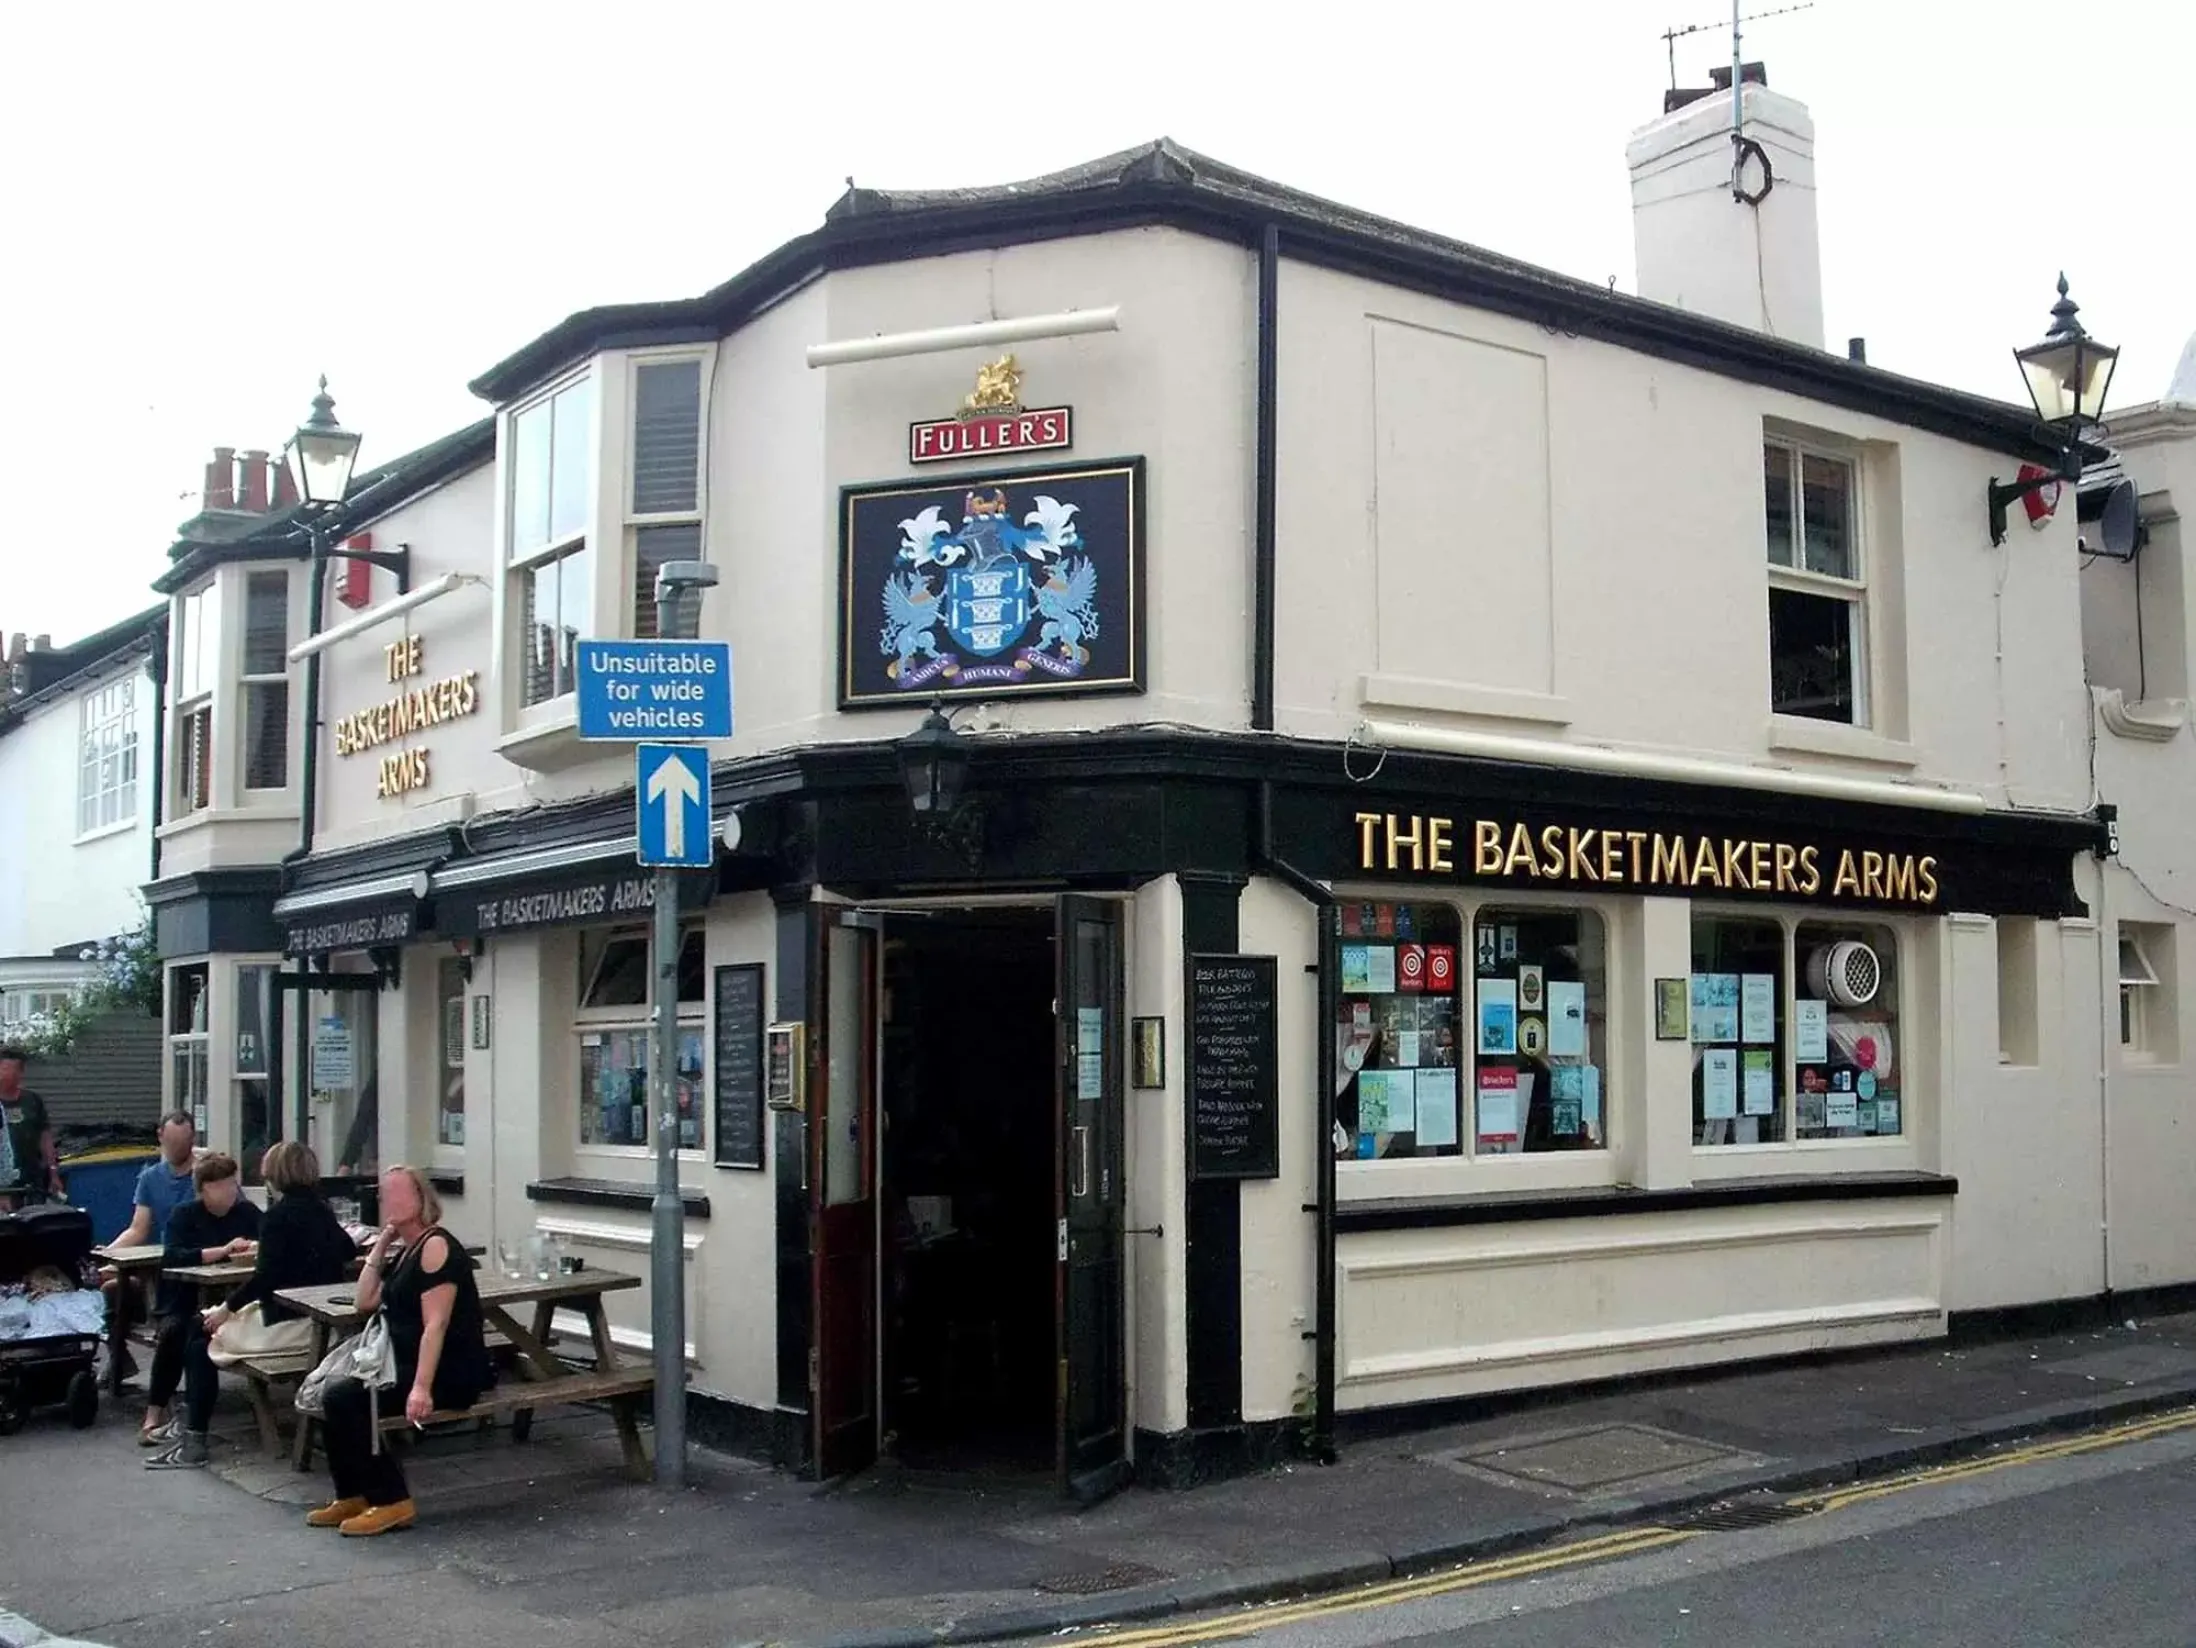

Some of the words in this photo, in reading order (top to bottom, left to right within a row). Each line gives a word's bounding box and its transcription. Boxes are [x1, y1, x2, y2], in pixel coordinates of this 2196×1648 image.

[919, 416, 1058, 454] FULLER'S
[384, 633, 423, 684] THE
[591, 652, 716, 674] Unsuitable
[963, 668, 1012, 681] HUMANI
[1027, 652, 1071, 675] GENERIS
[606, 680, 639, 701] for
[650, 680, 704, 701] wide
[335, 669, 480, 758] BASKETMAKERS
[608, 707, 704, 728] vehicles
[377, 745, 431, 800] ARMS
[1355, 812, 1454, 873] THE
[1475, 820, 1821, 896] BASKETMAKERS
[1833, 849, 1939, 904] ARMS
[477, 901, 498, 930] THE
[502, 885, 607, 926] BASKETMAKERS
[611, 878, 656, 912] ARMS
